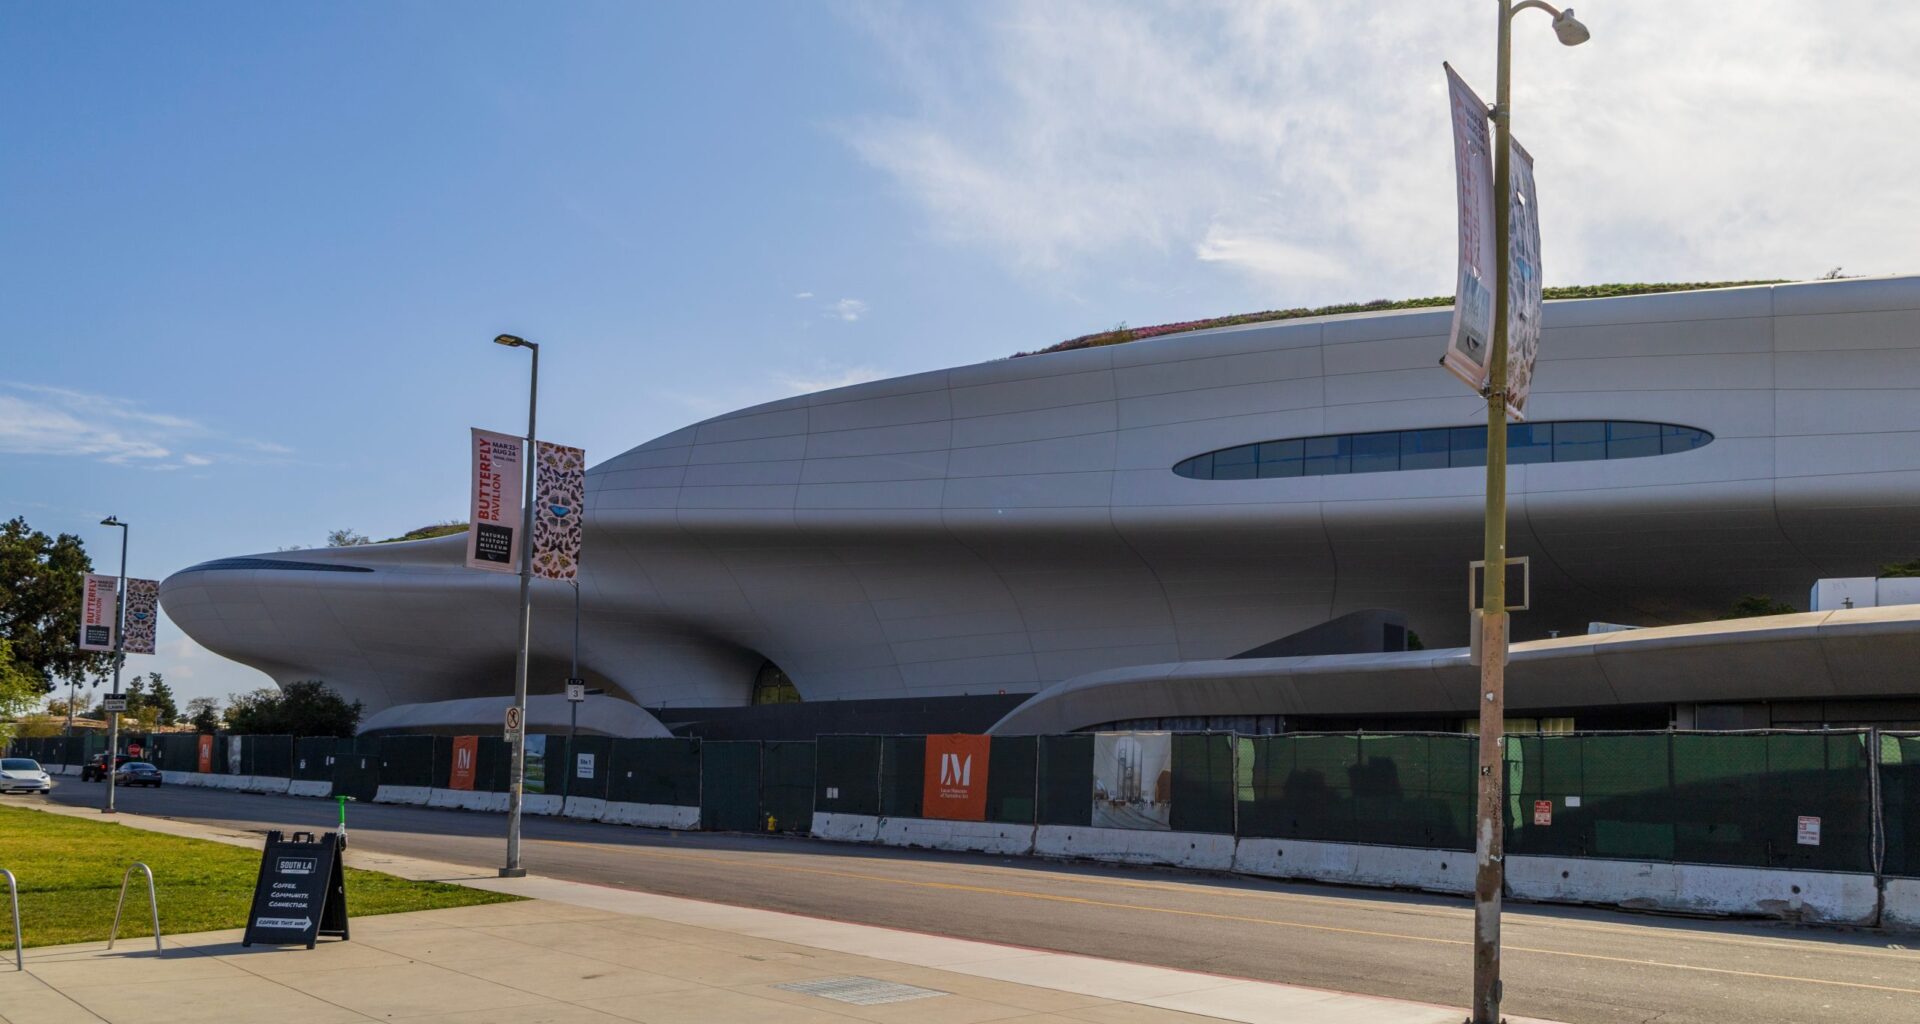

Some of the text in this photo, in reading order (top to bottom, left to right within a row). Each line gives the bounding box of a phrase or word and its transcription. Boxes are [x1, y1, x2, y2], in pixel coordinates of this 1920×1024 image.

[492, 441, 508, 449] MAR
[492, 447, 506, 455] AUG
[478, 438, 491, 520] BUTTERFLY
[491, 473, 501, 521] PAVILION
[480, 531, 508, 540] NATURAL
[480, 537, 508, 545] HISTORY
[87, 579, 96, 624] BUTTERFLY
[280, 861, 312, 870] SOUTH LA
